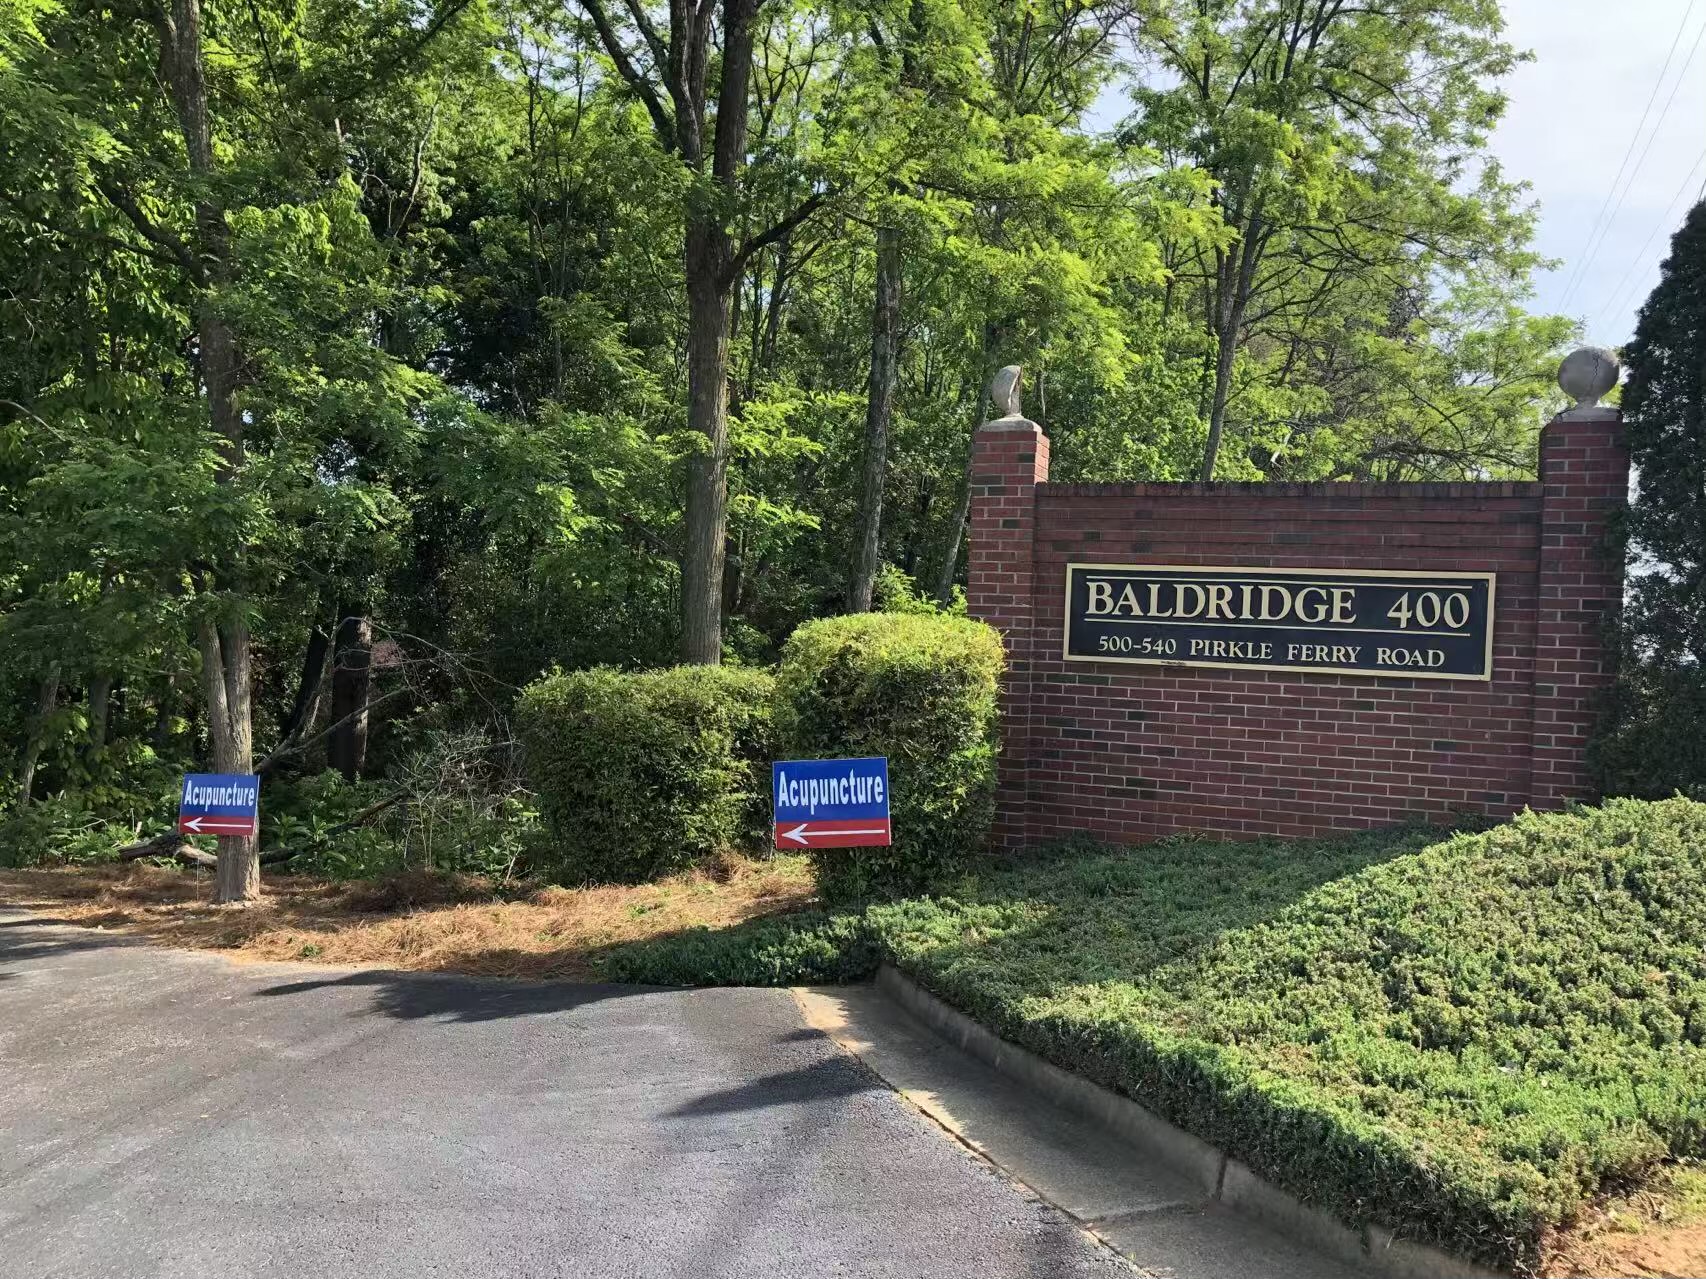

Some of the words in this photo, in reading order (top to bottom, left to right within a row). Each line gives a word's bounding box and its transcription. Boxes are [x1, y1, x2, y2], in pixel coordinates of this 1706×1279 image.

[1085, 581, 1357, 624] BALDRIDGE
[1387, 591, 1471, 629] 400
[1098, 635, 1177, 656] 500-540
[1189, 639, 1273, 660] PIRKLE
[1287, 643, 1362, 664] FERRY
[1376, 647, 1445, 667] ROAD
[184, 780, 255, 812] Acupuncture
[778, 768, 884, 815] Acupuncture
